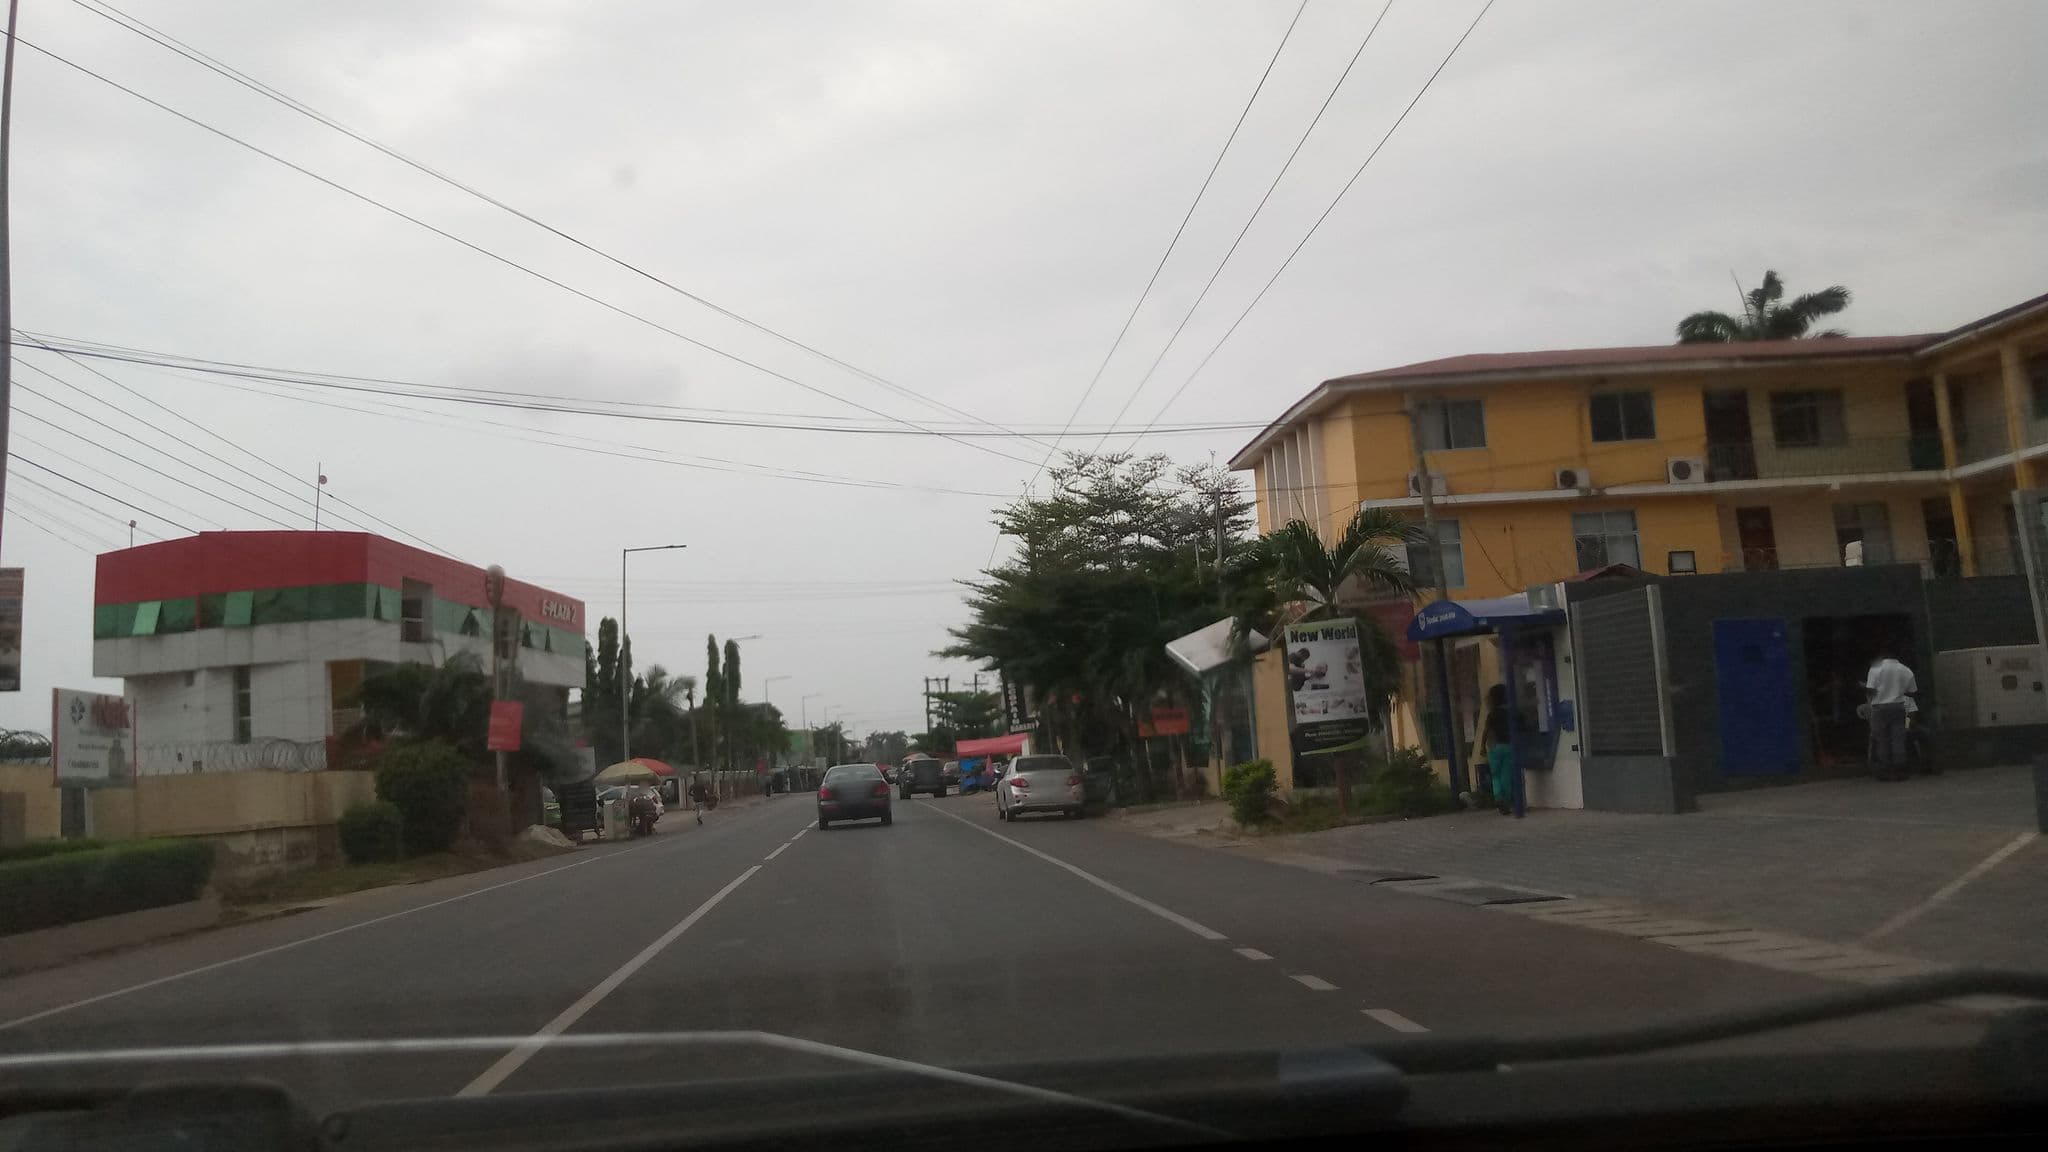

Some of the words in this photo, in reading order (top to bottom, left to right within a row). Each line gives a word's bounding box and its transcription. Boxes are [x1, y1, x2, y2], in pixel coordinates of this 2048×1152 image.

[571, 606, 577, 623] 2
[1290, 630, 1319, 643] New
[1321, 626, 1357, 641] World
